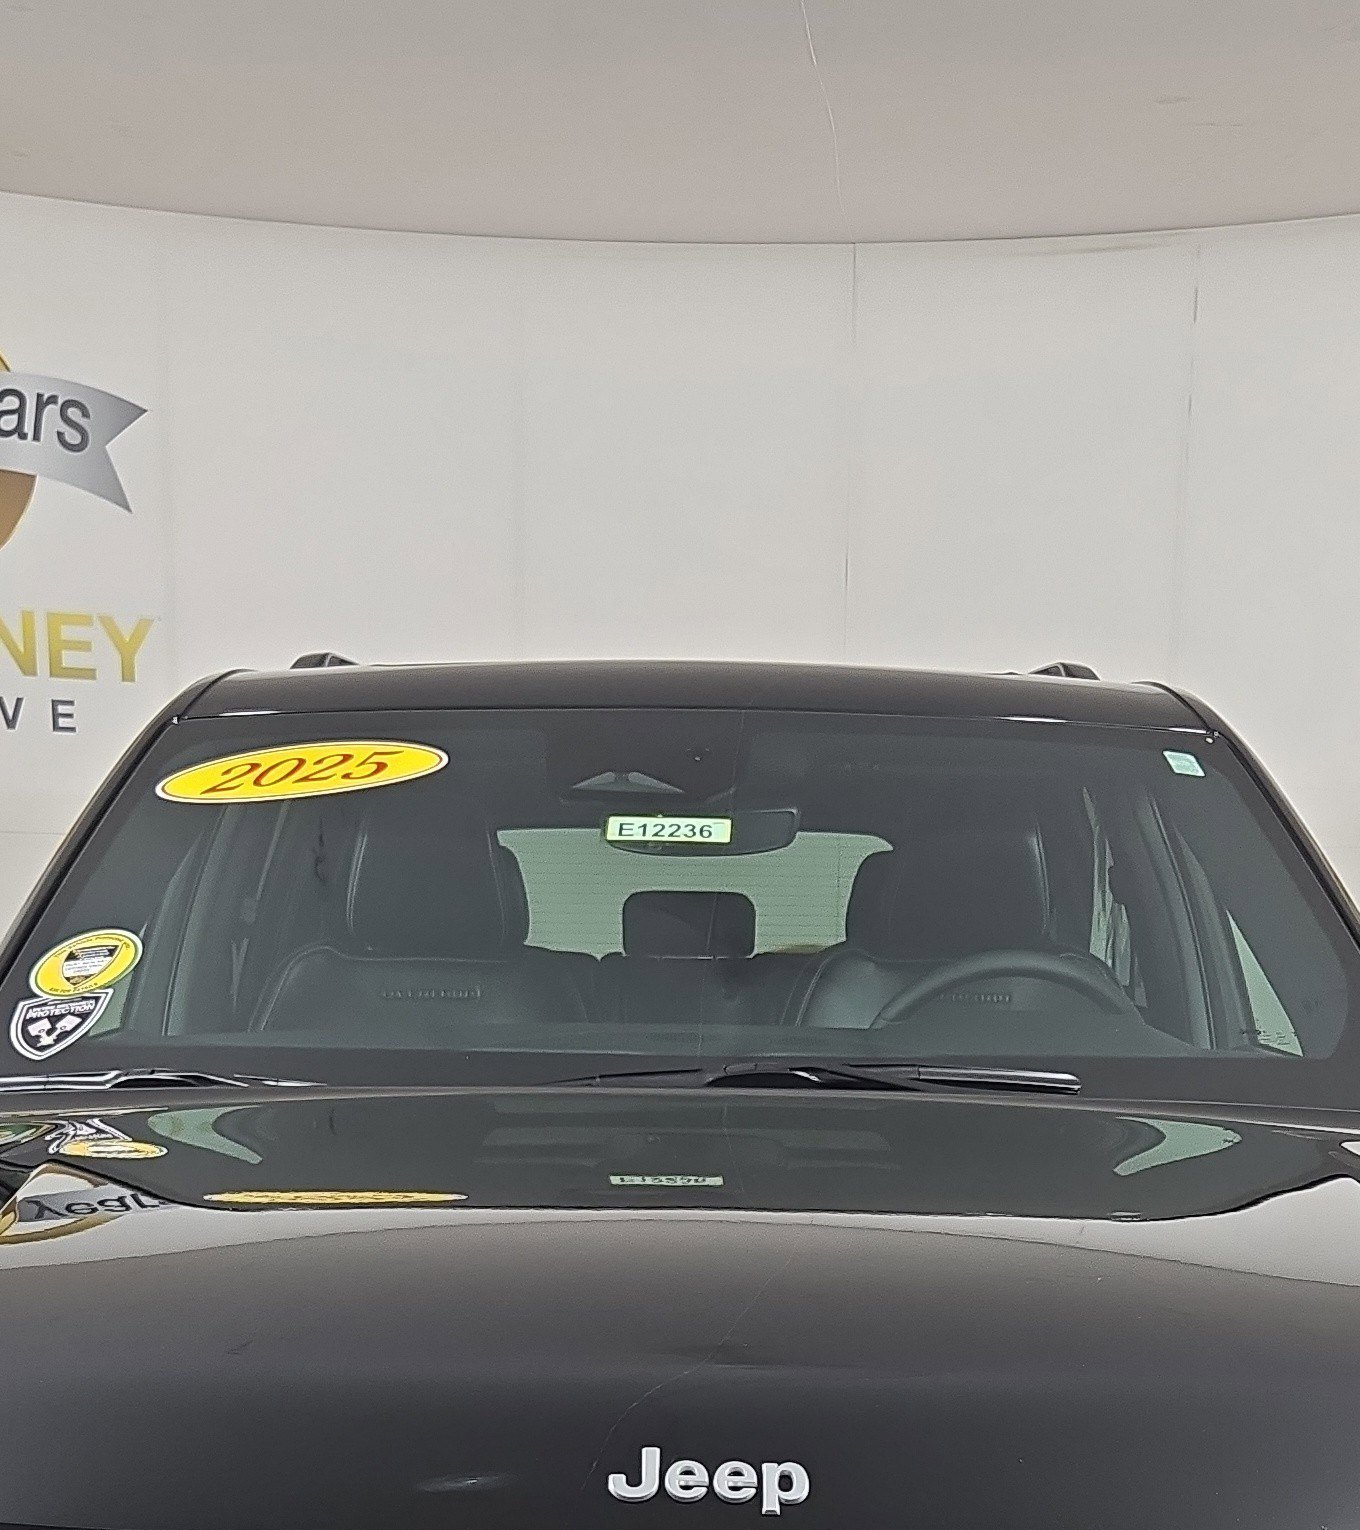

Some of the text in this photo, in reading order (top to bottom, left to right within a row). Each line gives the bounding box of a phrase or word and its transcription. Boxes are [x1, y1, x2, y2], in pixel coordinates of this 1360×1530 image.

[200, 751, 404, 795] 2025
[618, 823, 713, 838] E12236
[608, 1447, 810, 1515] Jeep
